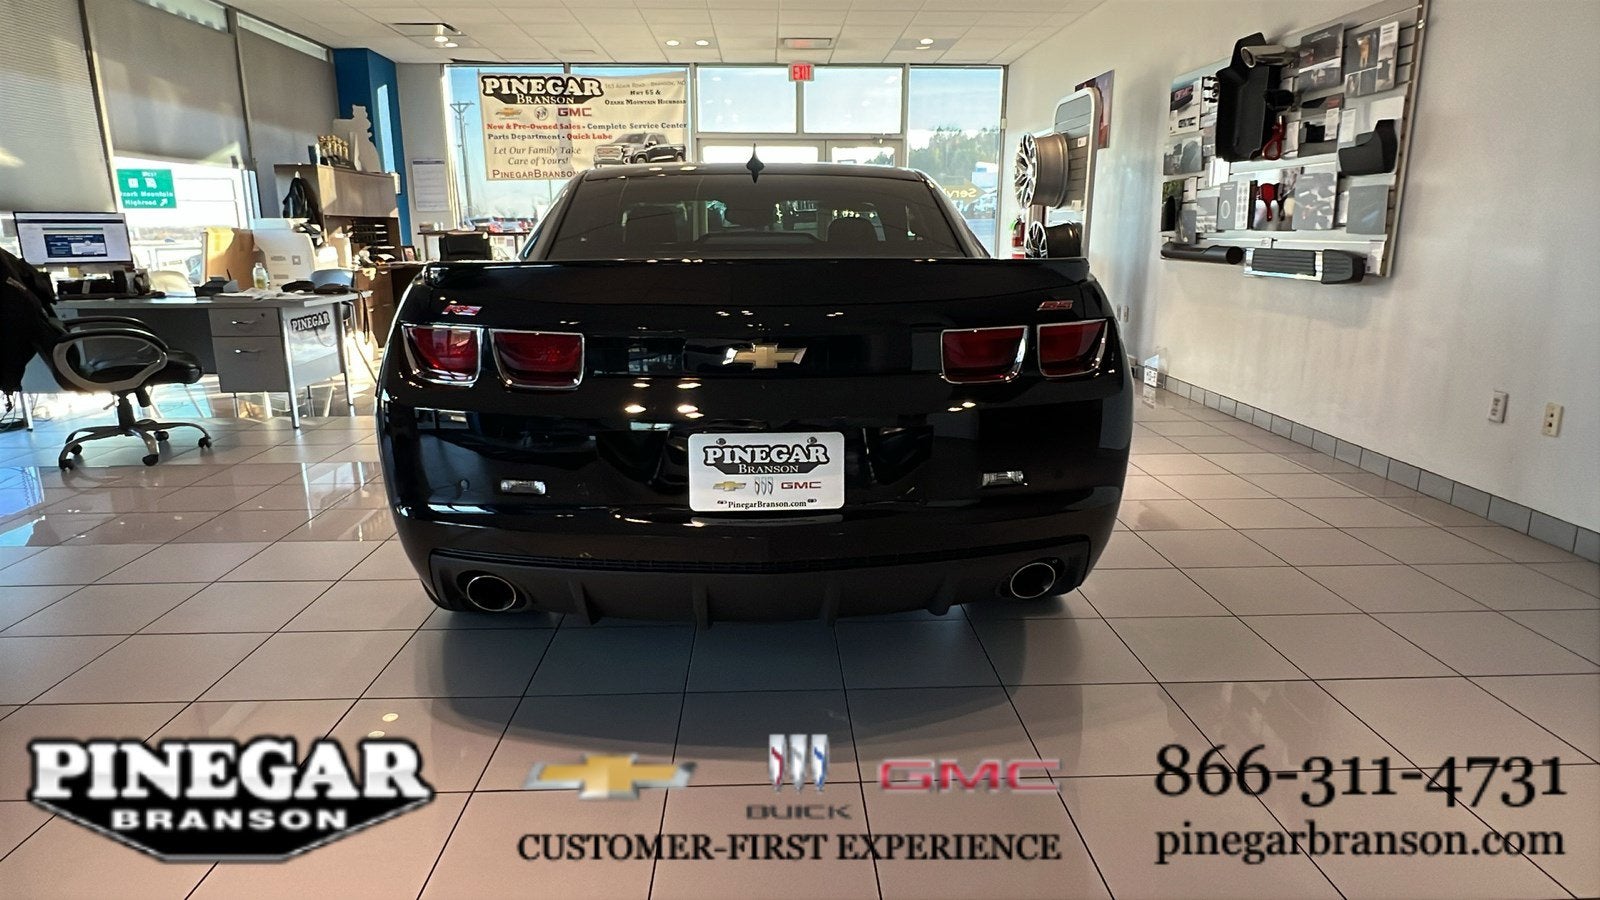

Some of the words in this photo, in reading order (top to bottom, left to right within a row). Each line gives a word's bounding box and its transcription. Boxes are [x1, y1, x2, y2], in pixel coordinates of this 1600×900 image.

[793, 65, 811, 80] EXIT
[483, 78, 603, 96] PINEGAR
[517, 94, 575, 104] BRANSON
[558, 108, 592, 116] GMC
[509, 146, 526, 154] Our
[528, 146, 557, 156] Family
[560, 146, 581, 154] Take
[508, 157, 528, 165] Care
[530, 157, 540, 166] of
[542, 157, 569, 165] Yours!
[291, 311, 330, 332] PINEGAR
[704, 446, 829, 465] PINEGAR
[738, 464, 799, 474] BRANSON
[781, 481, 821, 489] GMC
[728, 500, 807, 509] PinegarBranson.com
